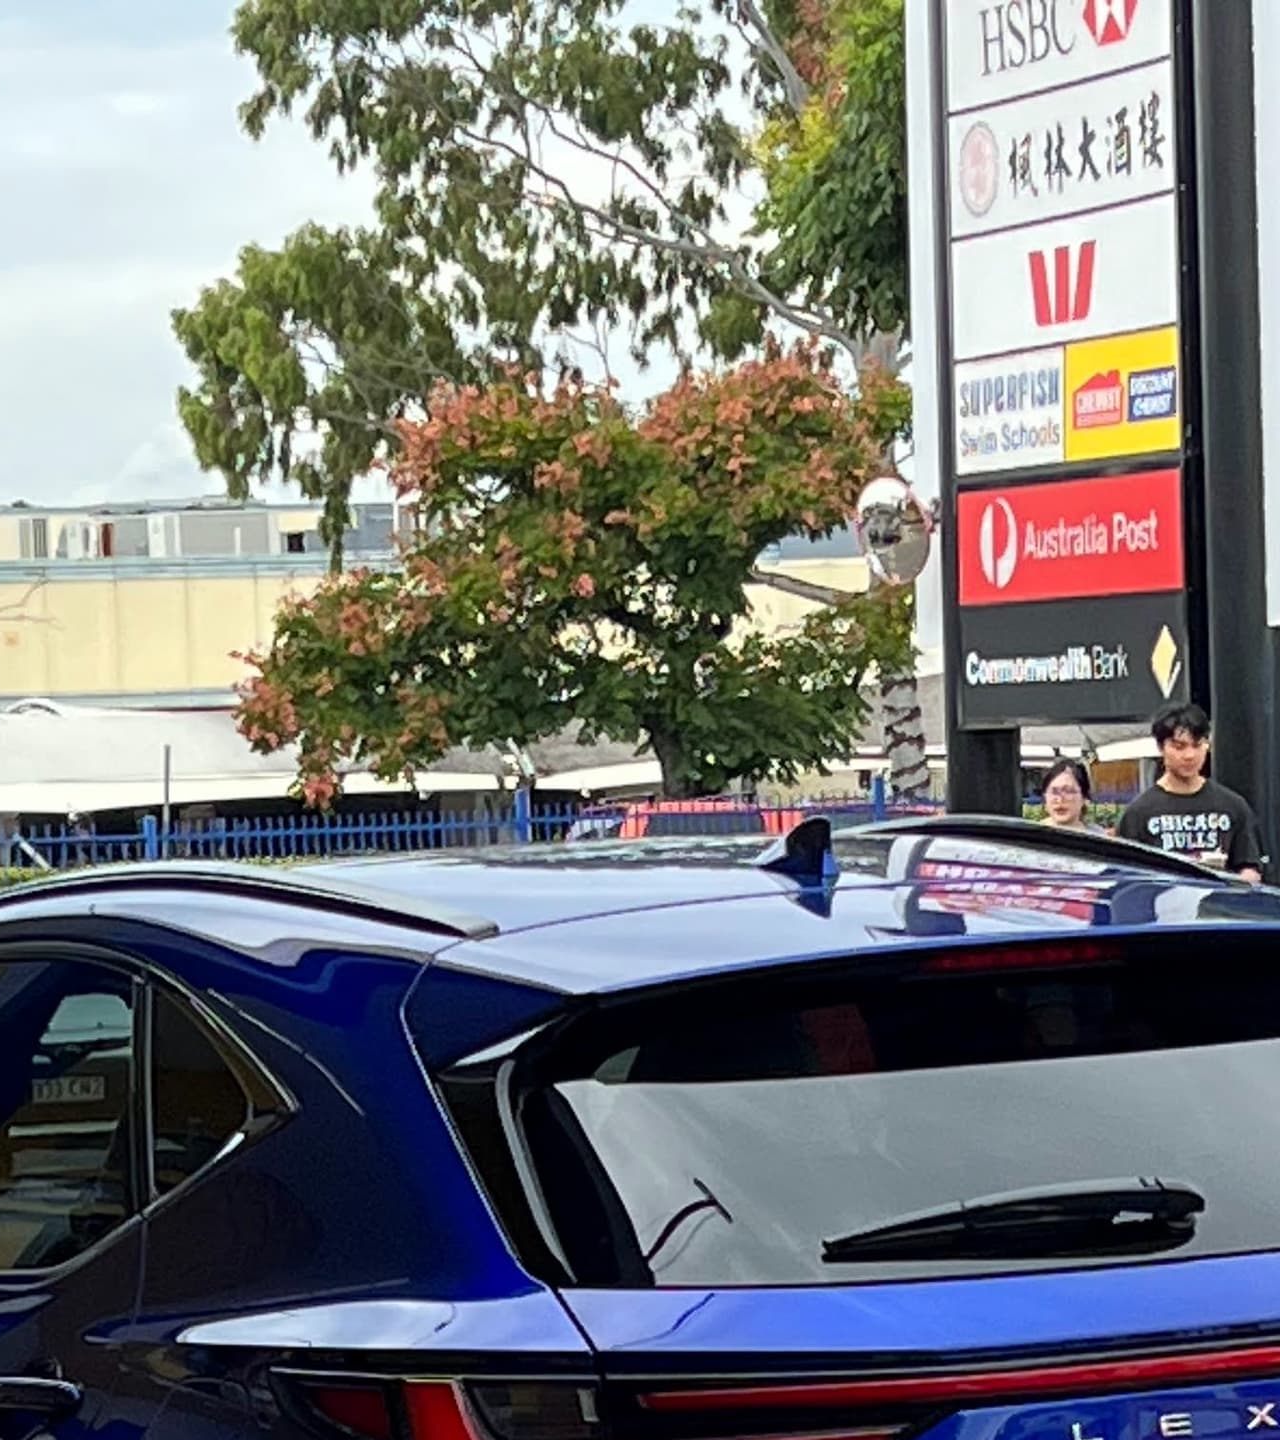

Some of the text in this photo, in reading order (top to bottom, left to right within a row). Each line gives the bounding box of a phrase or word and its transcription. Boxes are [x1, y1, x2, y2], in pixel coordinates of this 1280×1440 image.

[979, 0, 1077, 77] HSBC
[960, 367, 1060, 418] SUPERFISH
[1001, 416, 1060, 452] Schools
[1023, 507, 1159, 560] Australia Post
[1147, 812, 1231, 835] CHICAGO
[1160, 831, 1219, 850] BULLS
